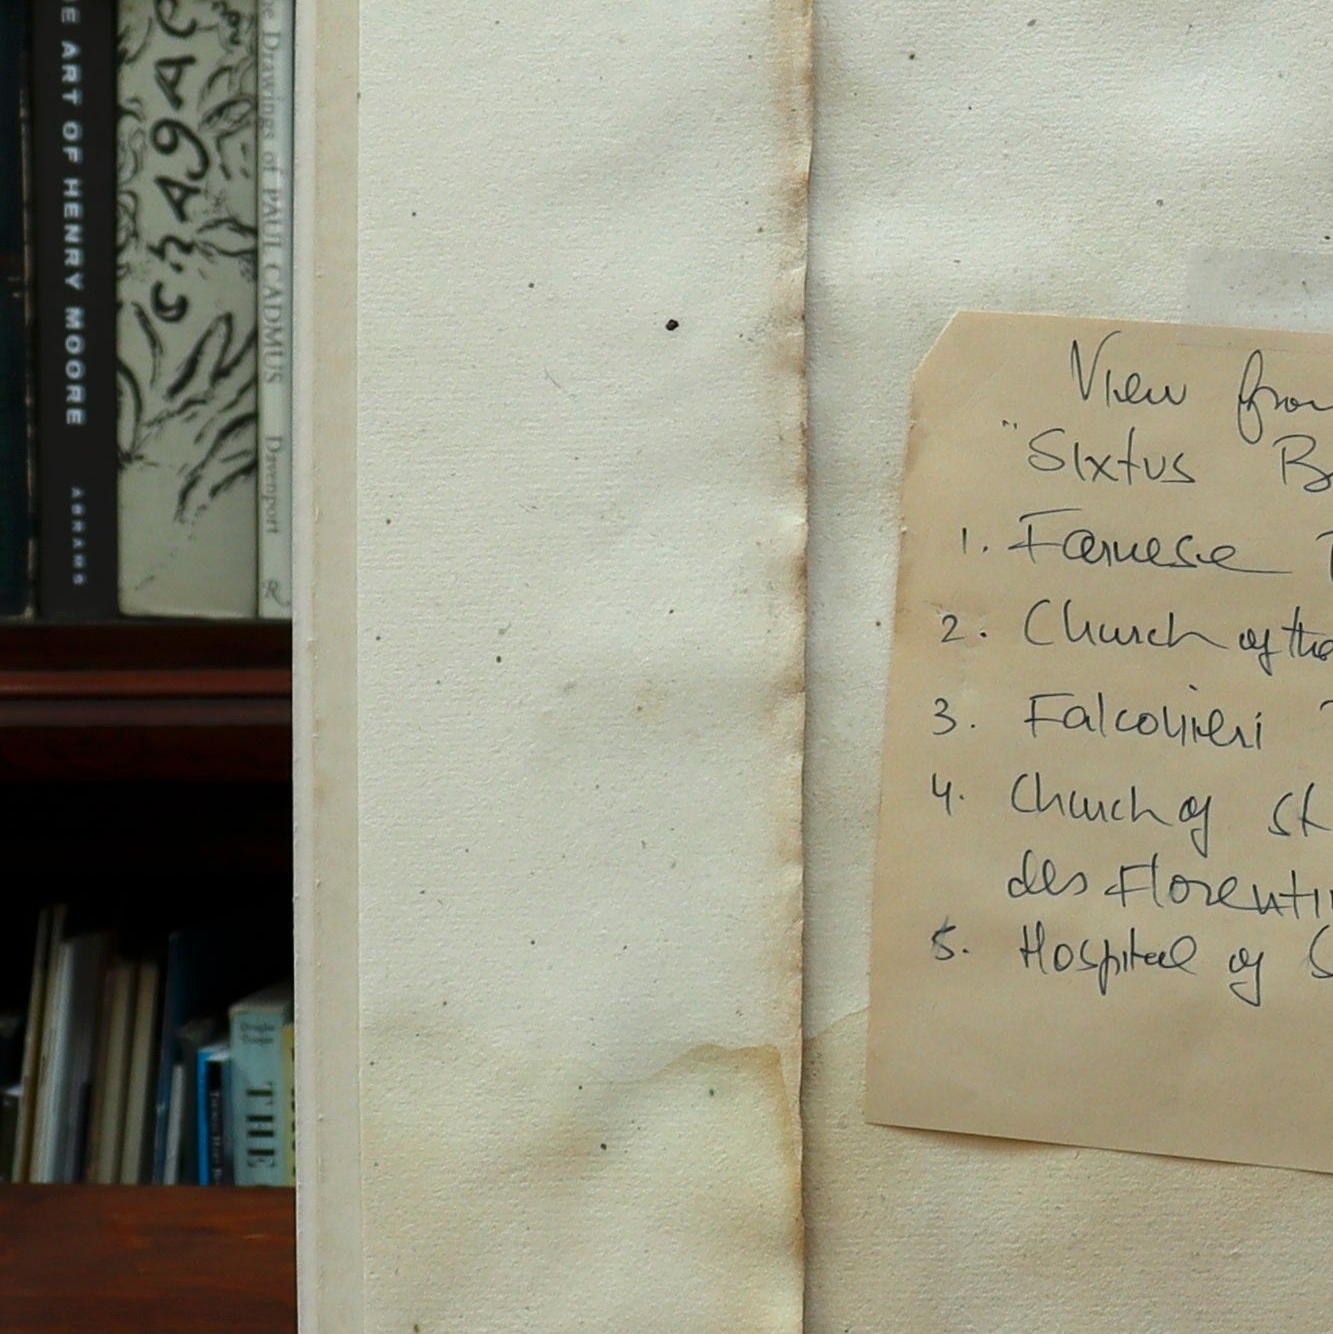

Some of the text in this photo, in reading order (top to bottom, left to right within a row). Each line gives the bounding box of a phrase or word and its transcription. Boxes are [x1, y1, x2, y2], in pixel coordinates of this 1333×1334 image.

[61, 40, 83, 107] ART
[259, 31, 283, 140] Drawings
[61, 120, 84, 165] OF
[261, 150, 282, 178] of
[62, 176, 85, 291] HENRY
[262, 186, 282, 254] PAUL
[262, 262, 284, 385] CADMUS
[64, 306, 87, 426] MOORE
[1072, 331, 1188, 409] View
[262, 435, 284, 535] Davenport
[70, 485, 87, 587] ABRAMS
[940, 613, 988, 644] 2.
[1023, 599, 1230, 648] Church
[931, 699, 976, 736] 3.
[930, 773, 966, 808] 4.
[1010, 772, 1172, 826] Church
[1007, 850, 1088, 900] des
[930, 917, 970, 963] 5.
